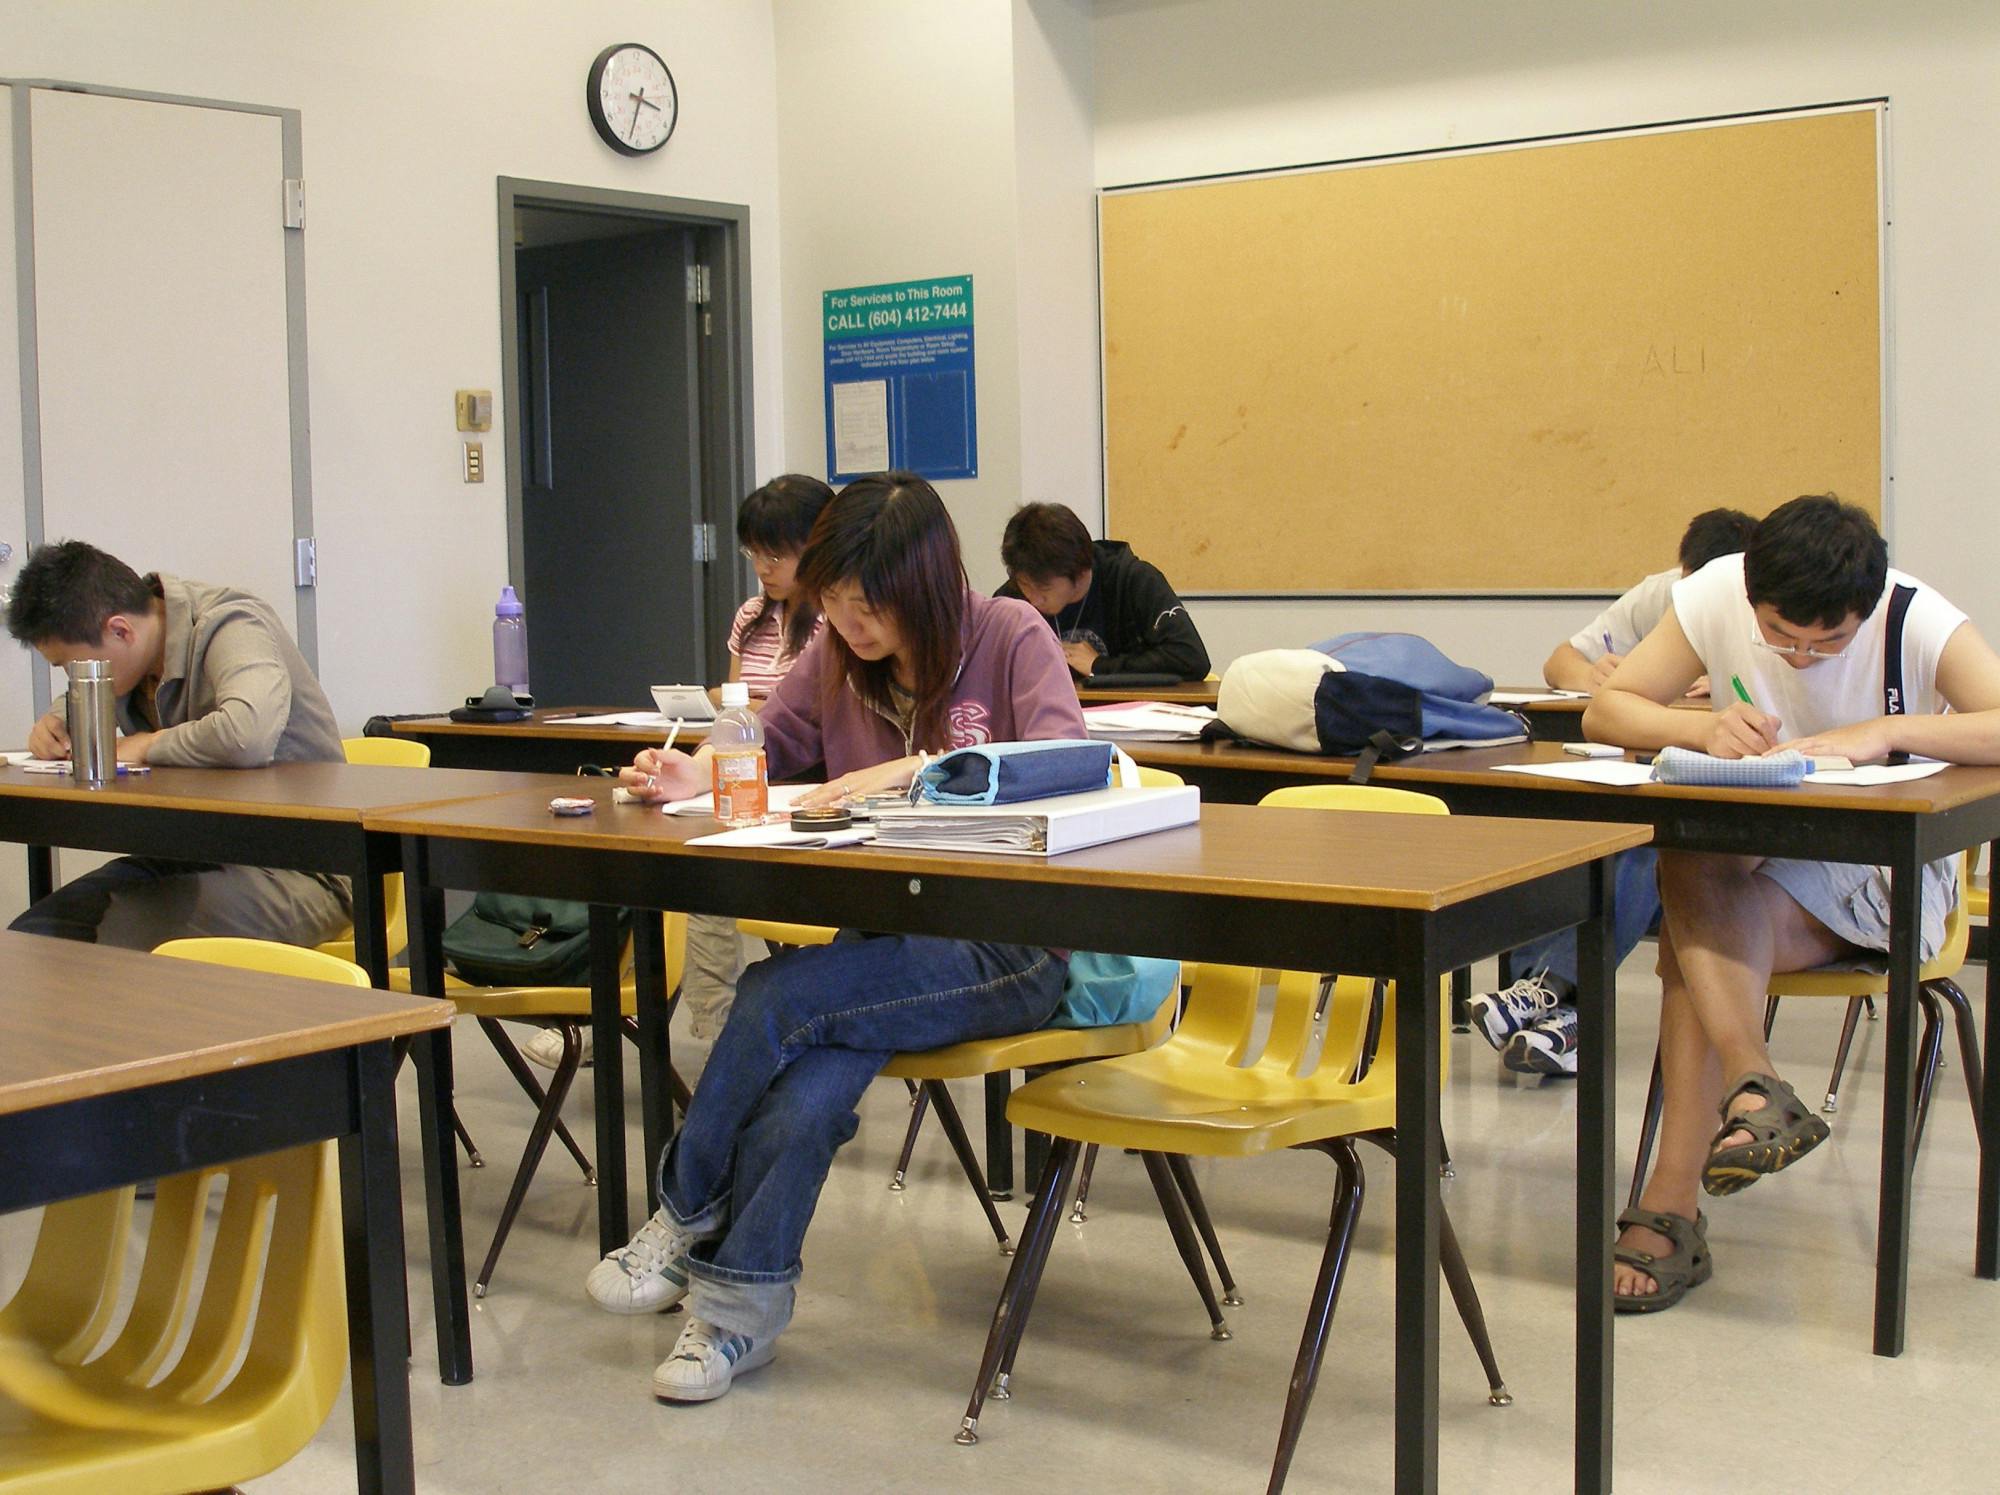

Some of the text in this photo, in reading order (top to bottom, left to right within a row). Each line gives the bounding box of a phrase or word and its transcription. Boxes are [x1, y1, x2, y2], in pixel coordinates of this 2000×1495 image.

[831, 285, 963, 309] For Services to This Room
[828, 302, 967, 331] CALL (604) 412-7444
[1887, 688, 1899, 714] FILA
